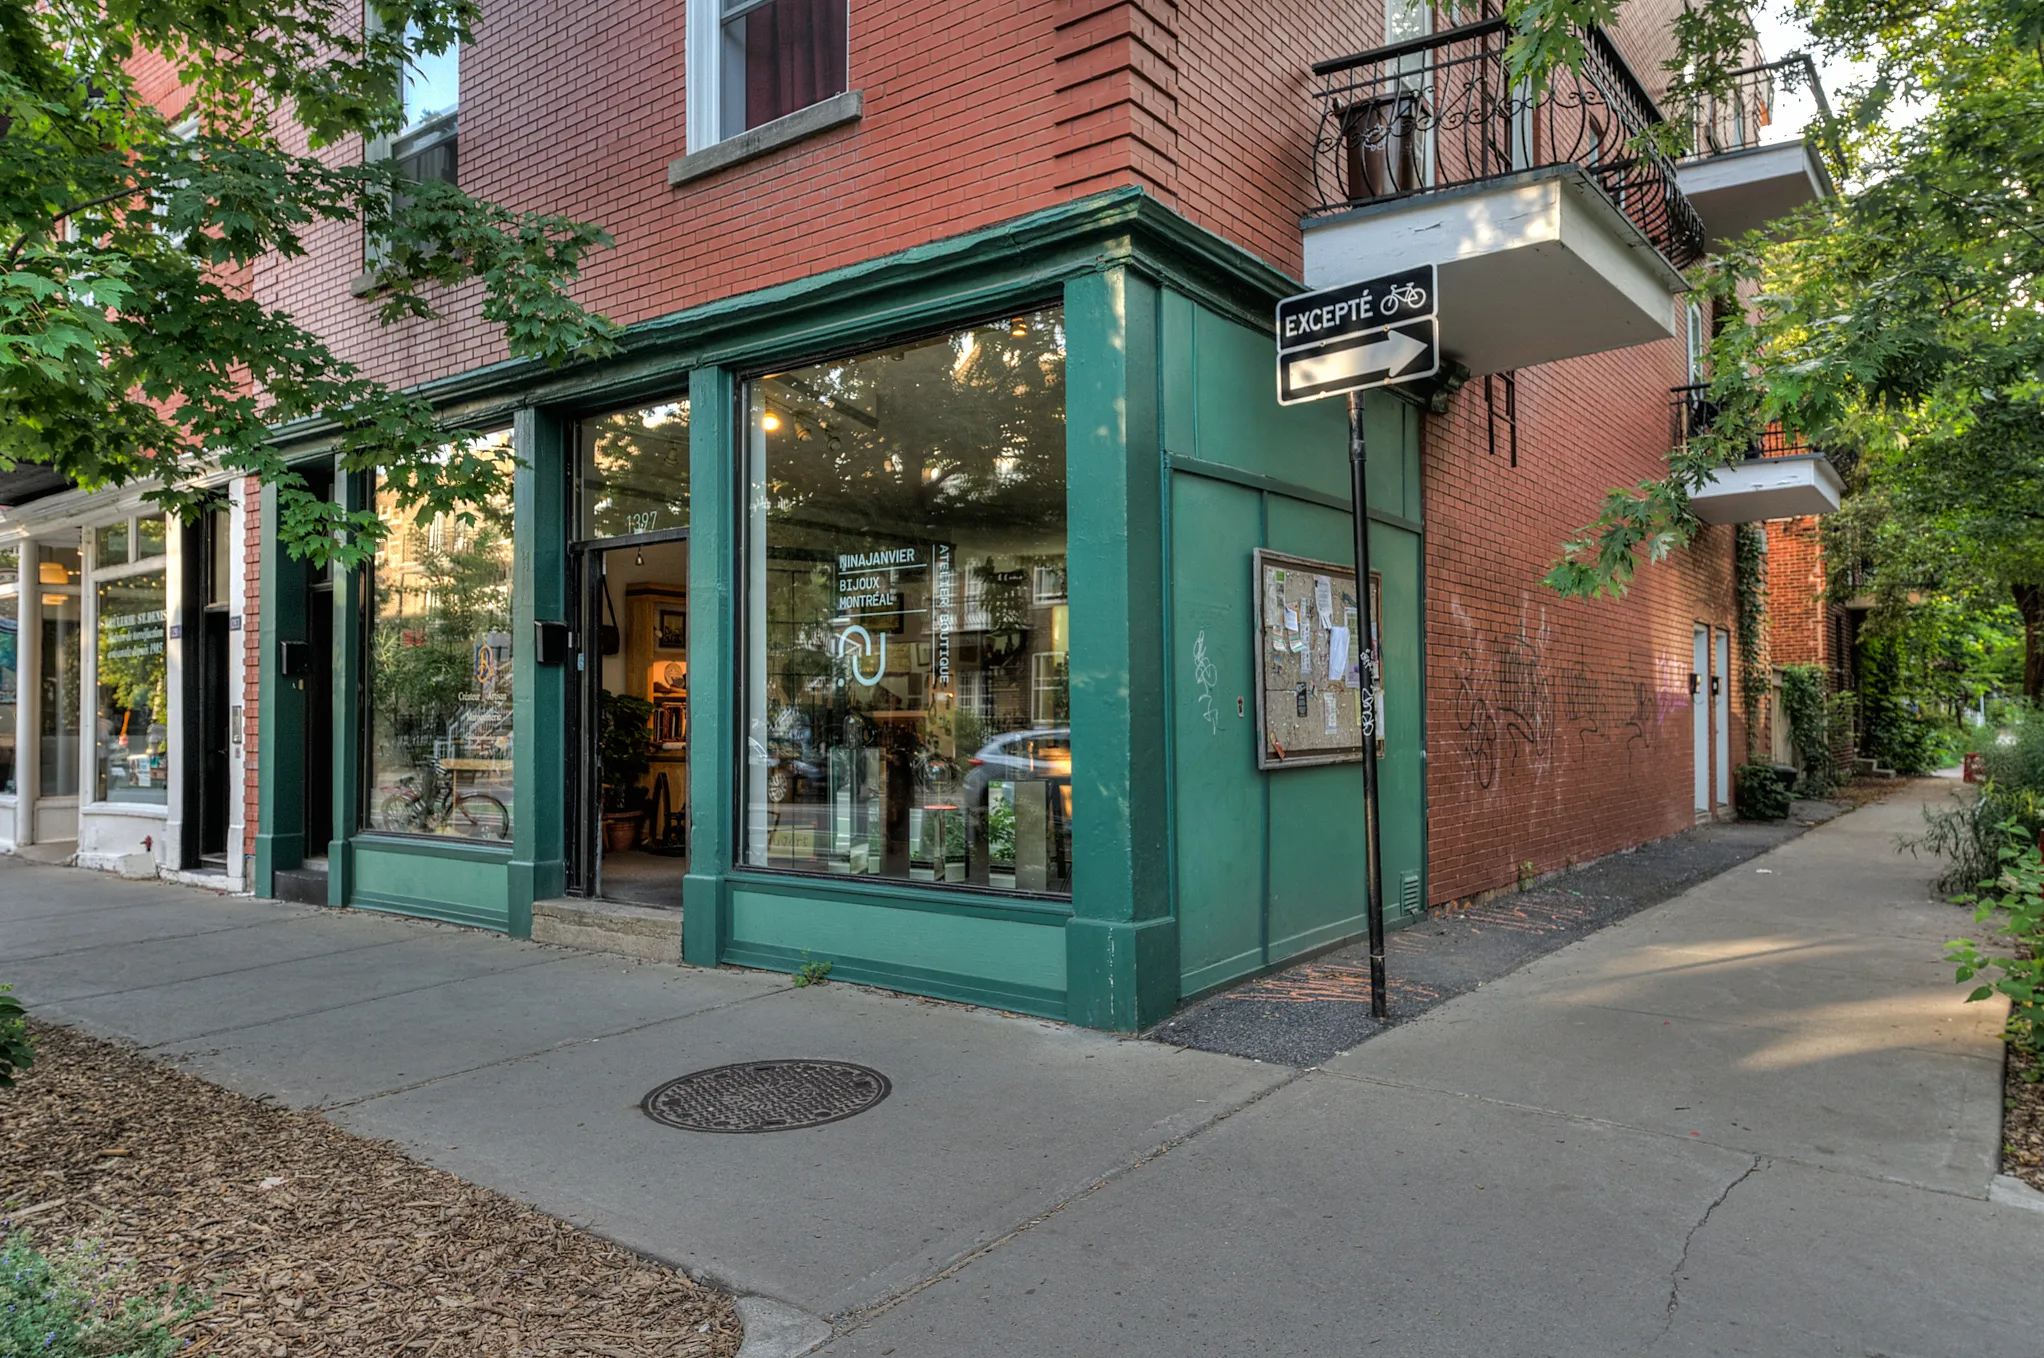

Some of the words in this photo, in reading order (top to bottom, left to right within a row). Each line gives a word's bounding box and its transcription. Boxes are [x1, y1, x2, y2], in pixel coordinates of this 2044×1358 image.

[1285, 289, 1373, 338] EXCEPTÉ
[626, 511, 657, 533] 1397
[839, 547, 915, 570] NINAJANVIER
[839, 576, 880, 592] BIJOUX
[939, 544, 950, 608] ATELIER
[839, 591, 894, 609] MONTRÉAL
[939, 613, 950, 685] BOUTIQUE
[457, 691, 481, 702] Créateur
[487, 691, 507, 702] Artisan
